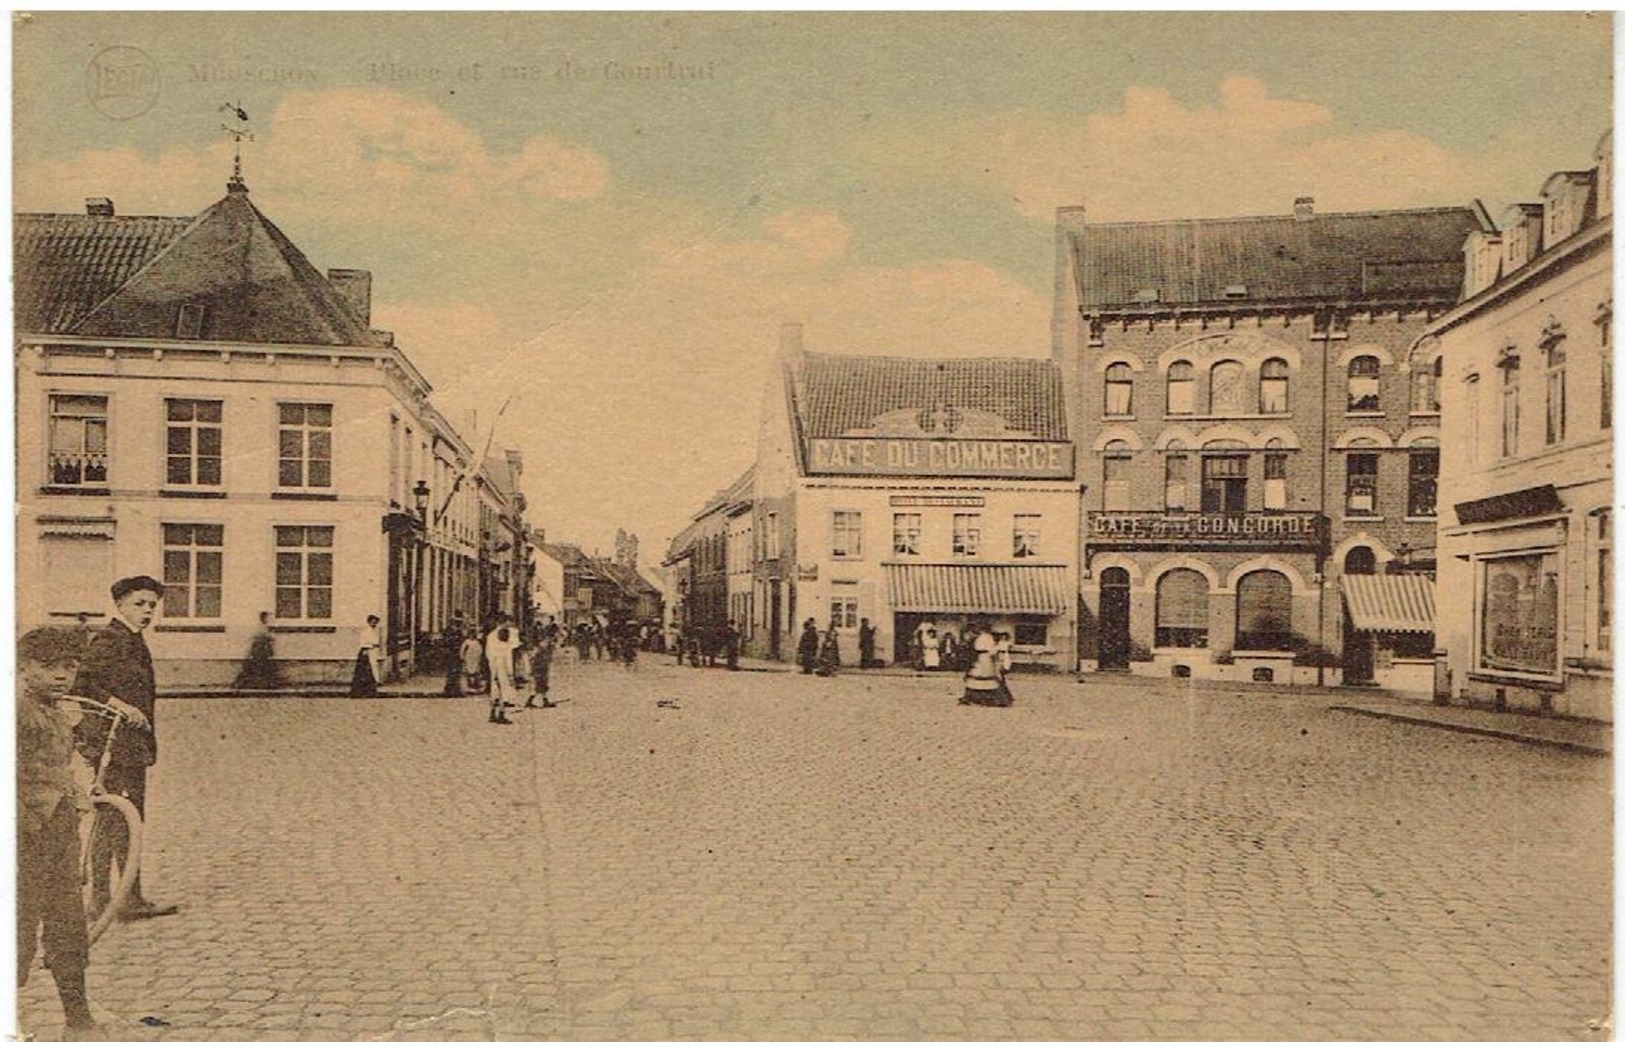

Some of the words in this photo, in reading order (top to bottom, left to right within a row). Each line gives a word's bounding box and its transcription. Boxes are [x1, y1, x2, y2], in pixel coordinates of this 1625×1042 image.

[888, 440, 918, 468] DU
[929, 441, 1064, 470] COMMERCE
[1196, 516, 1317, 534] CONCORDE
